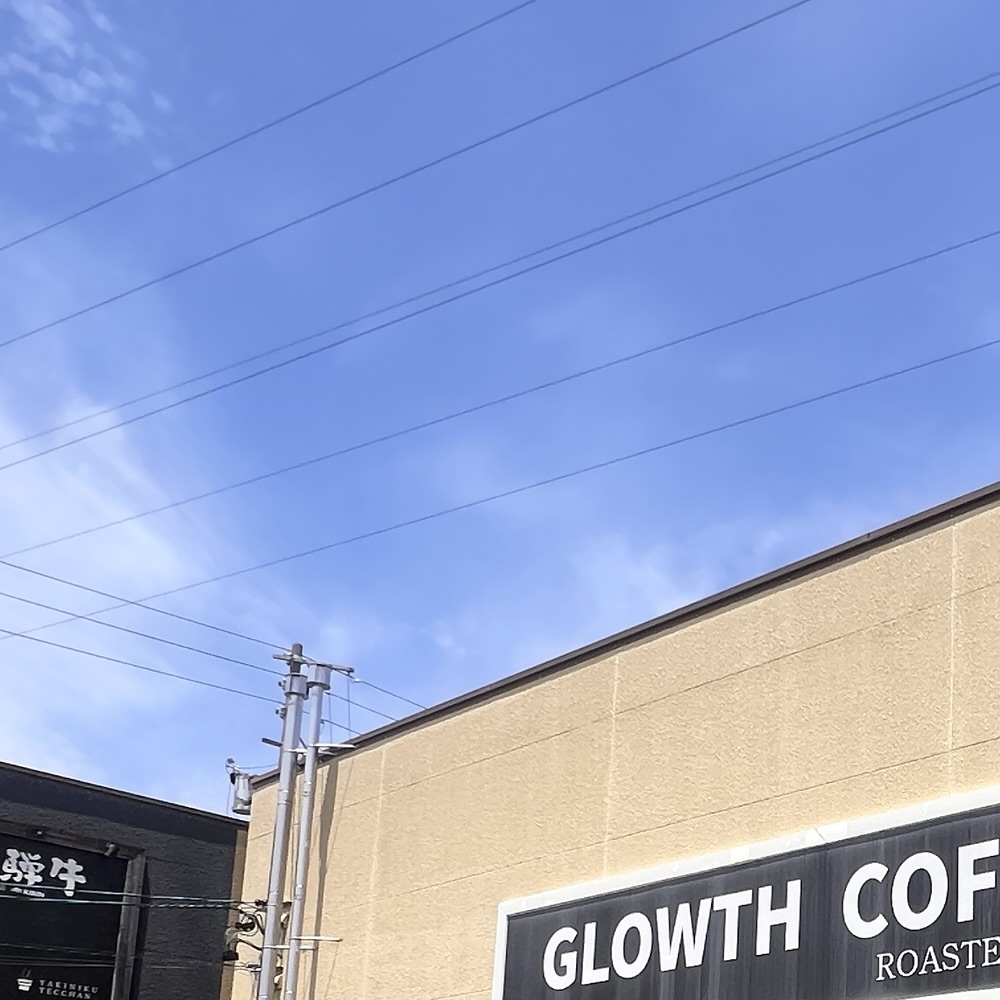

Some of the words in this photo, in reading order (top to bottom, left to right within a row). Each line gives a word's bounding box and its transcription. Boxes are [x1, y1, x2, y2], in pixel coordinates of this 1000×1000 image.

[543, 879, 801, 990] GLOWTH
[39, 979, 99, 994] YAKINIKU
[39, 987, 92, 1000] TECCHAN
